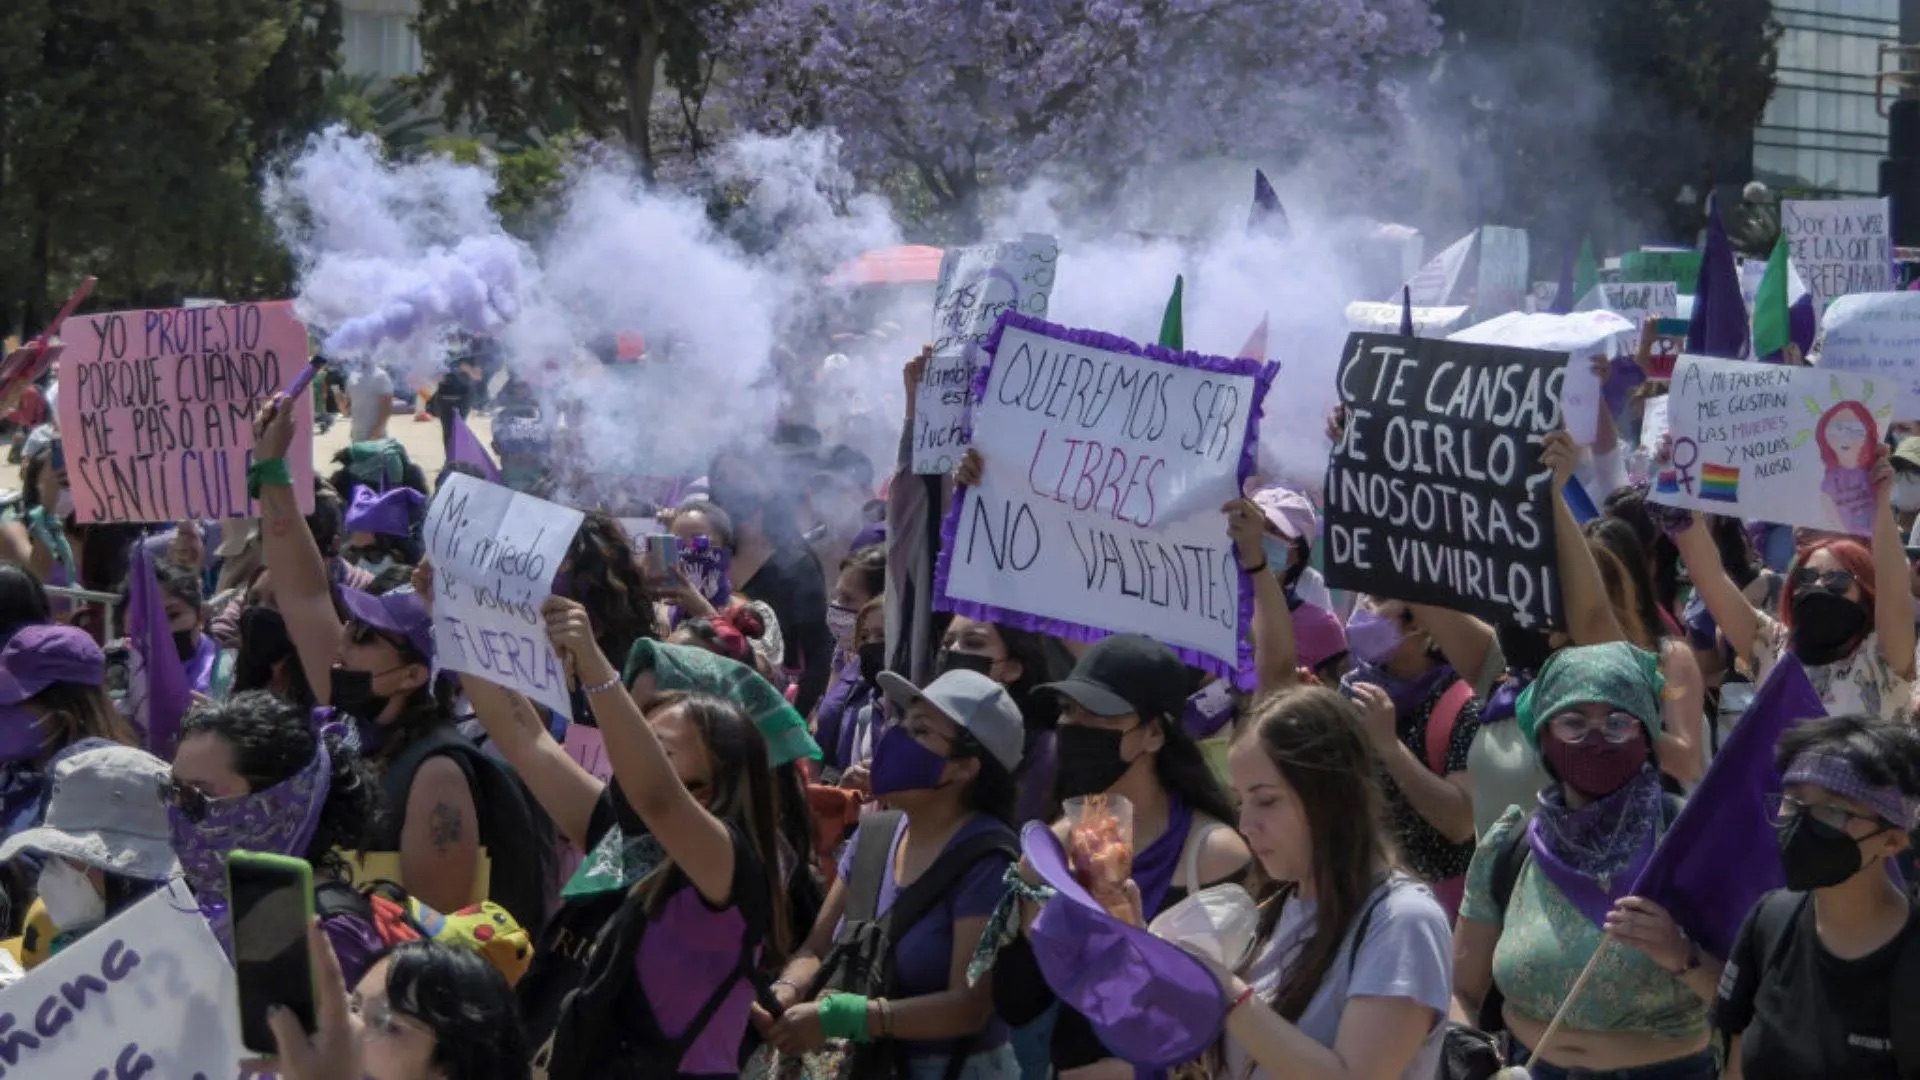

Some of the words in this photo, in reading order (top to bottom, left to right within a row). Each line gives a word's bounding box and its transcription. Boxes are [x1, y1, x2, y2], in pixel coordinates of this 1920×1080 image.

[91, 314, 127, 360] YO
[145, 305, 261, 356] PROTESTO
[77, 356, 165, 410] PORQUE
[176, 350, 280, 402] CUANDO
[999, 342, 1175, 442] QUEREMOS
[1180, 380, 1240, 463] SER
[1425, 360, 1569, 431] CANSAS
[1681, 362, 1705, 397] A
[1698, 398, 1722, 421] ME
[1728, 392, 1788, 415] GUSTAN
[80, 408, 117, 457] ME
[204, 403, 224, 448] A
[1698, 425, 1728, 444] LAS
[1724, 445, 1738, 463] Y
[1741, 441, 1766, 461] NO
[1767, 436, 1790, 454] LAS
[1029, 428, 1166, 529] LIBRES
[433, 487, 470, 560] Mi
[471, 526, 545, 582] miedo
[966, 495, 1041, 572] NO
[1067, 520, 1235, 631] VALIENTES
[1330, 524, 1372, 569] DE
[445, 616, 565, 699] FUERZA
[0, 939, 141, 1076] ñana
